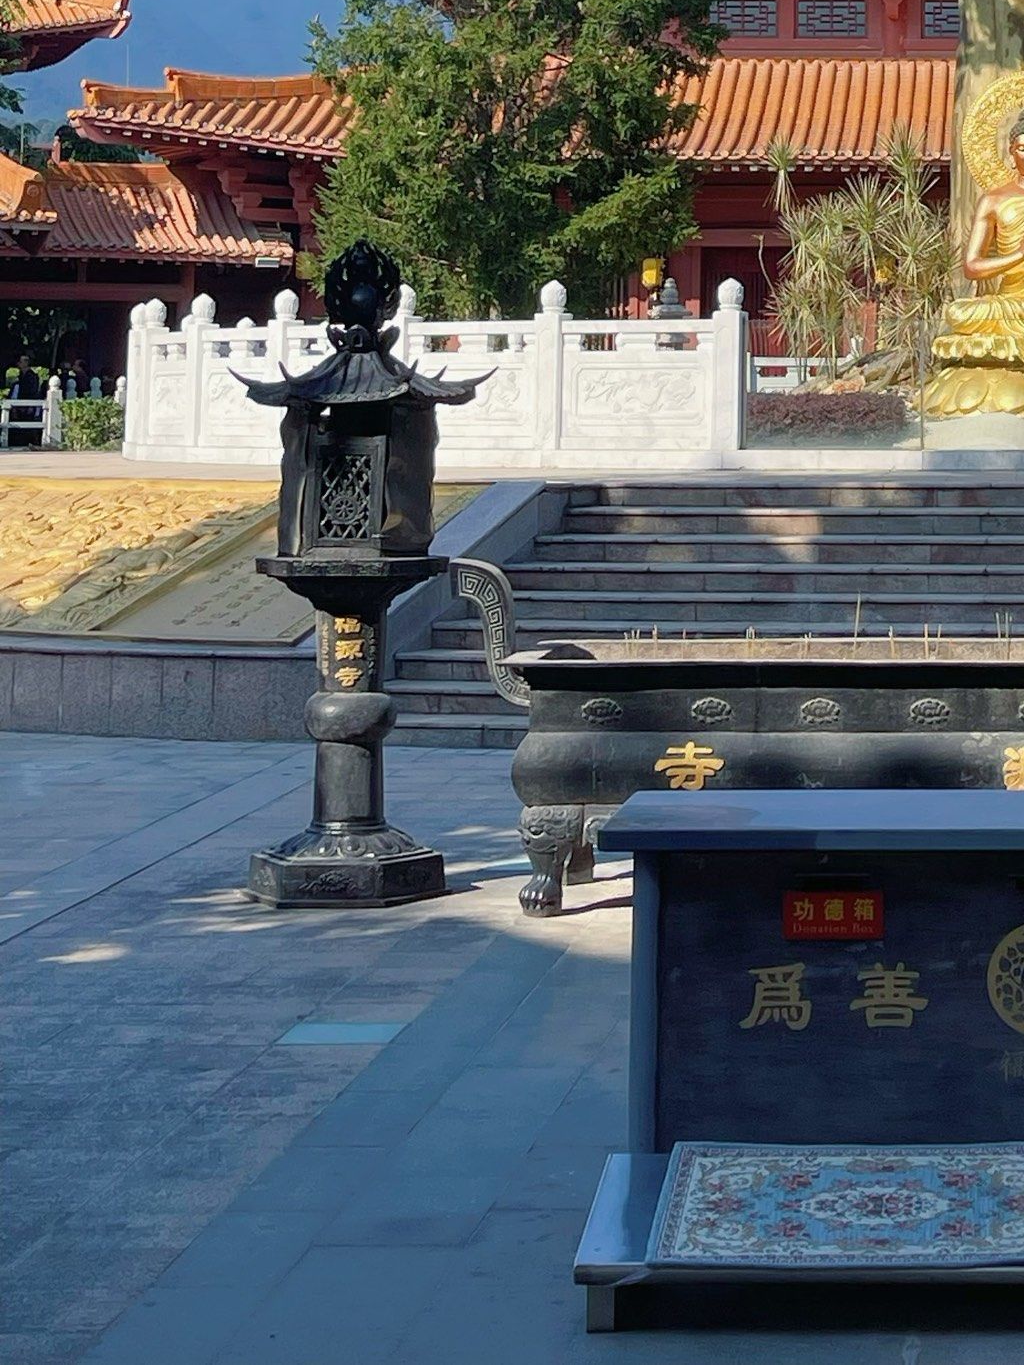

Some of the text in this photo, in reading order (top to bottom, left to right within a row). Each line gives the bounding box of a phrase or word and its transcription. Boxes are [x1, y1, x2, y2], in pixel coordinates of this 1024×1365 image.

[334, 617, 364, 687] 福源寺
[654, 741, 725, 791] 寺
[792, 898, 874, 922] 功德箱
